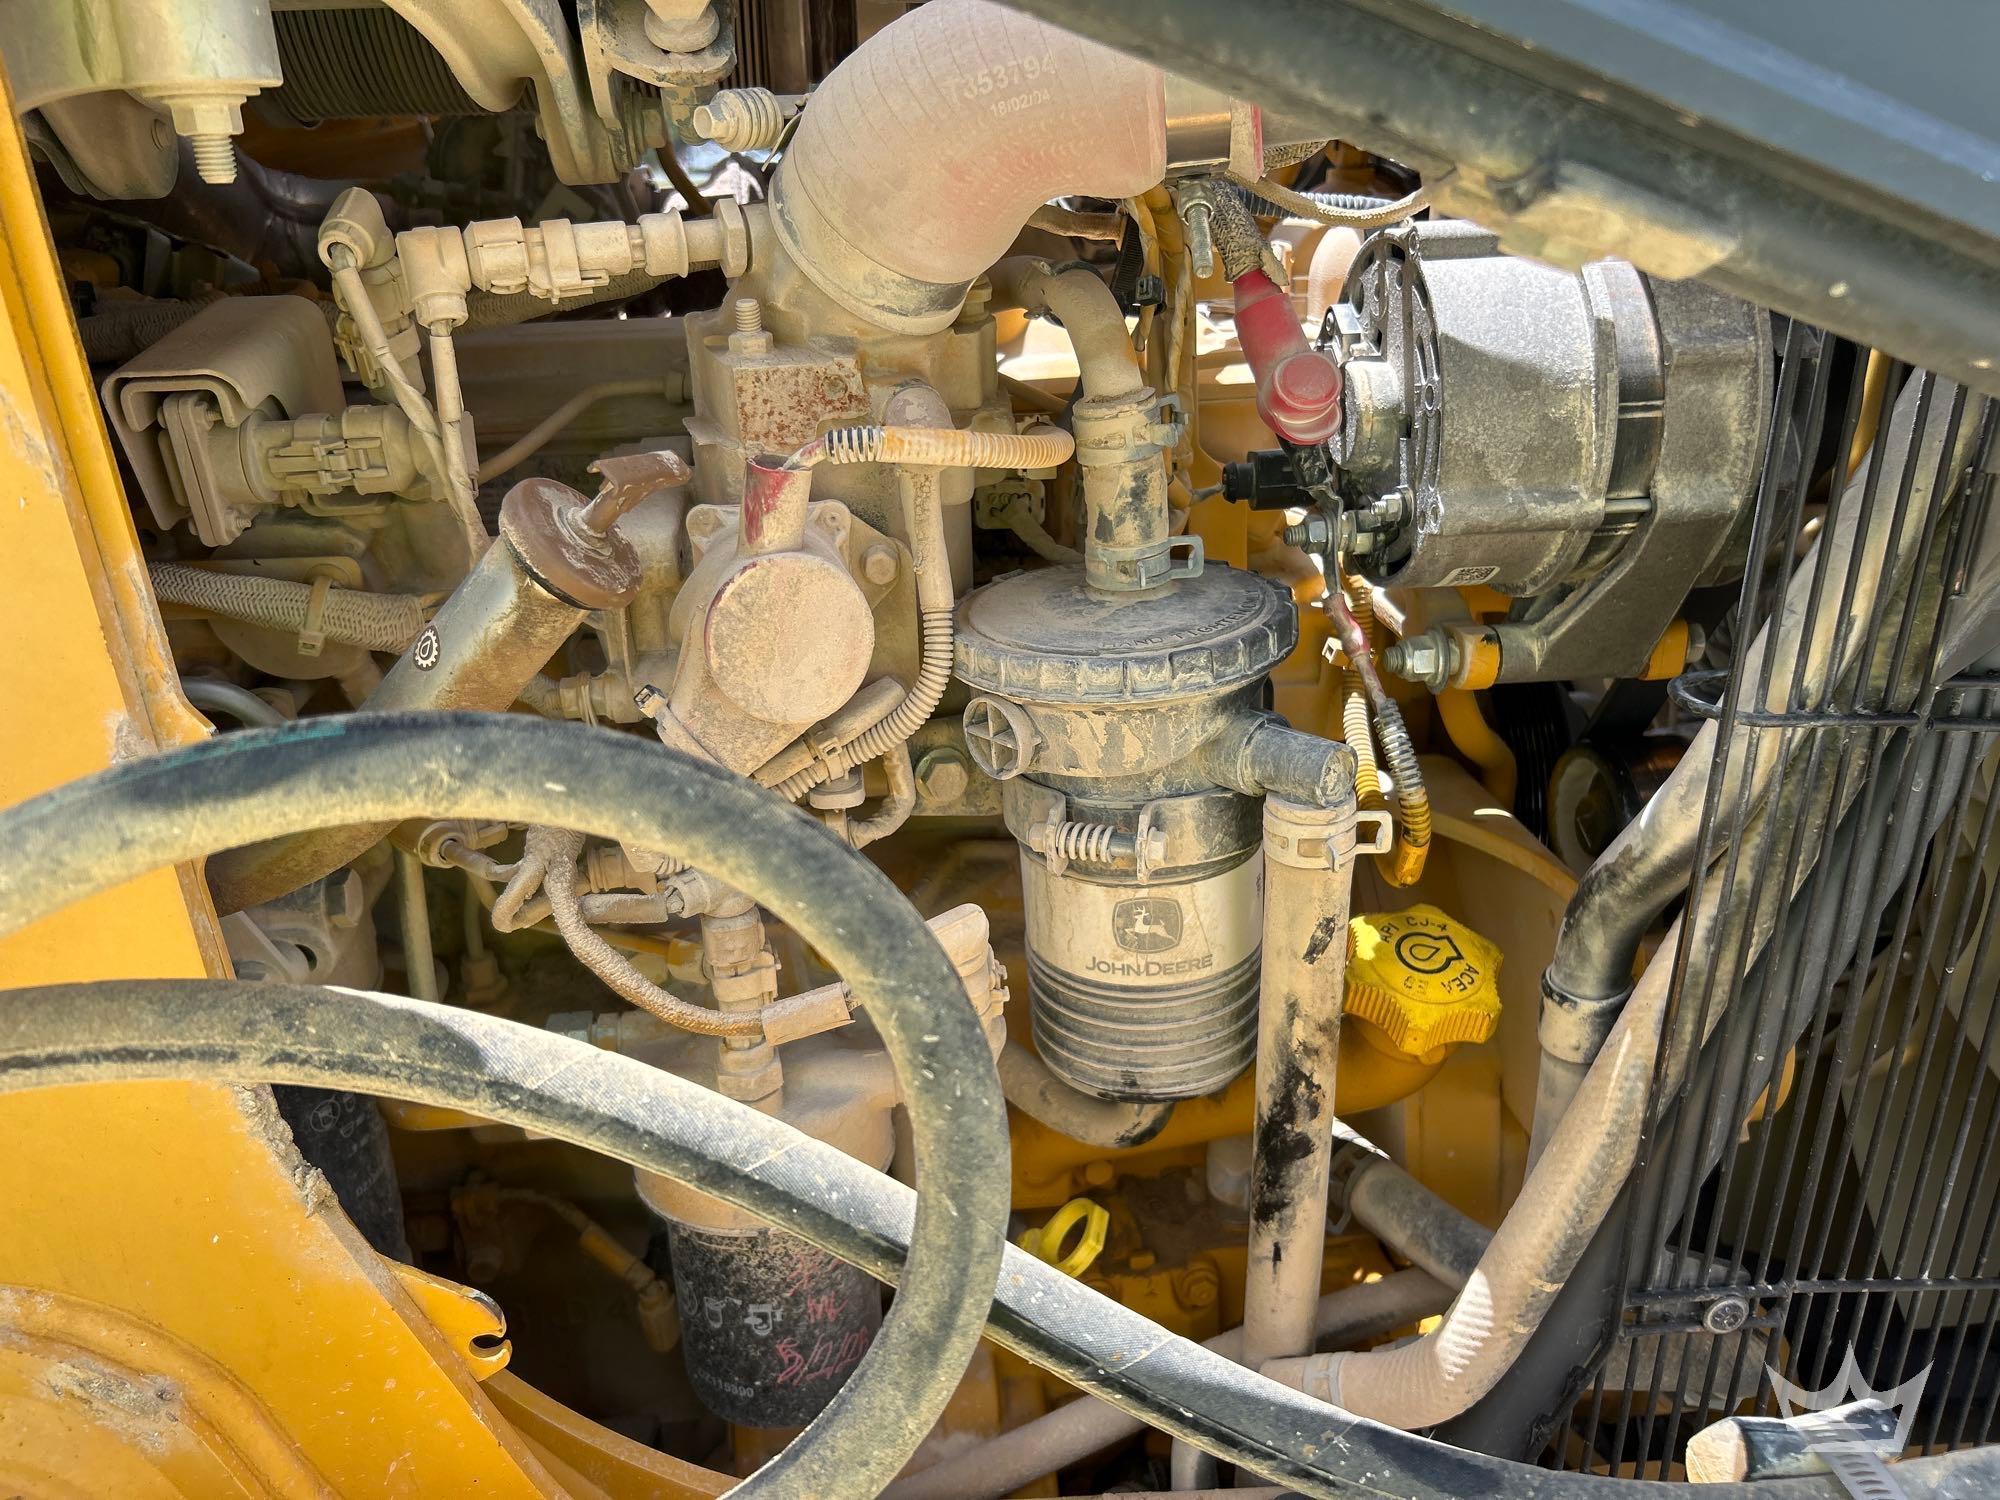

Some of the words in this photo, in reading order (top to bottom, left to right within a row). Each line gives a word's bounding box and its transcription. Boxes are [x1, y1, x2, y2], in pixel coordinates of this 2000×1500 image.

[1102, 636, 1163, 649] HAND
[1171, 607, 1252, 641] TIGHTEN
[1379, 922, 1400, 944] API
[1085, 956, 1141, 976] JOHN
[1145, 953, 1213, 976] DEERE
